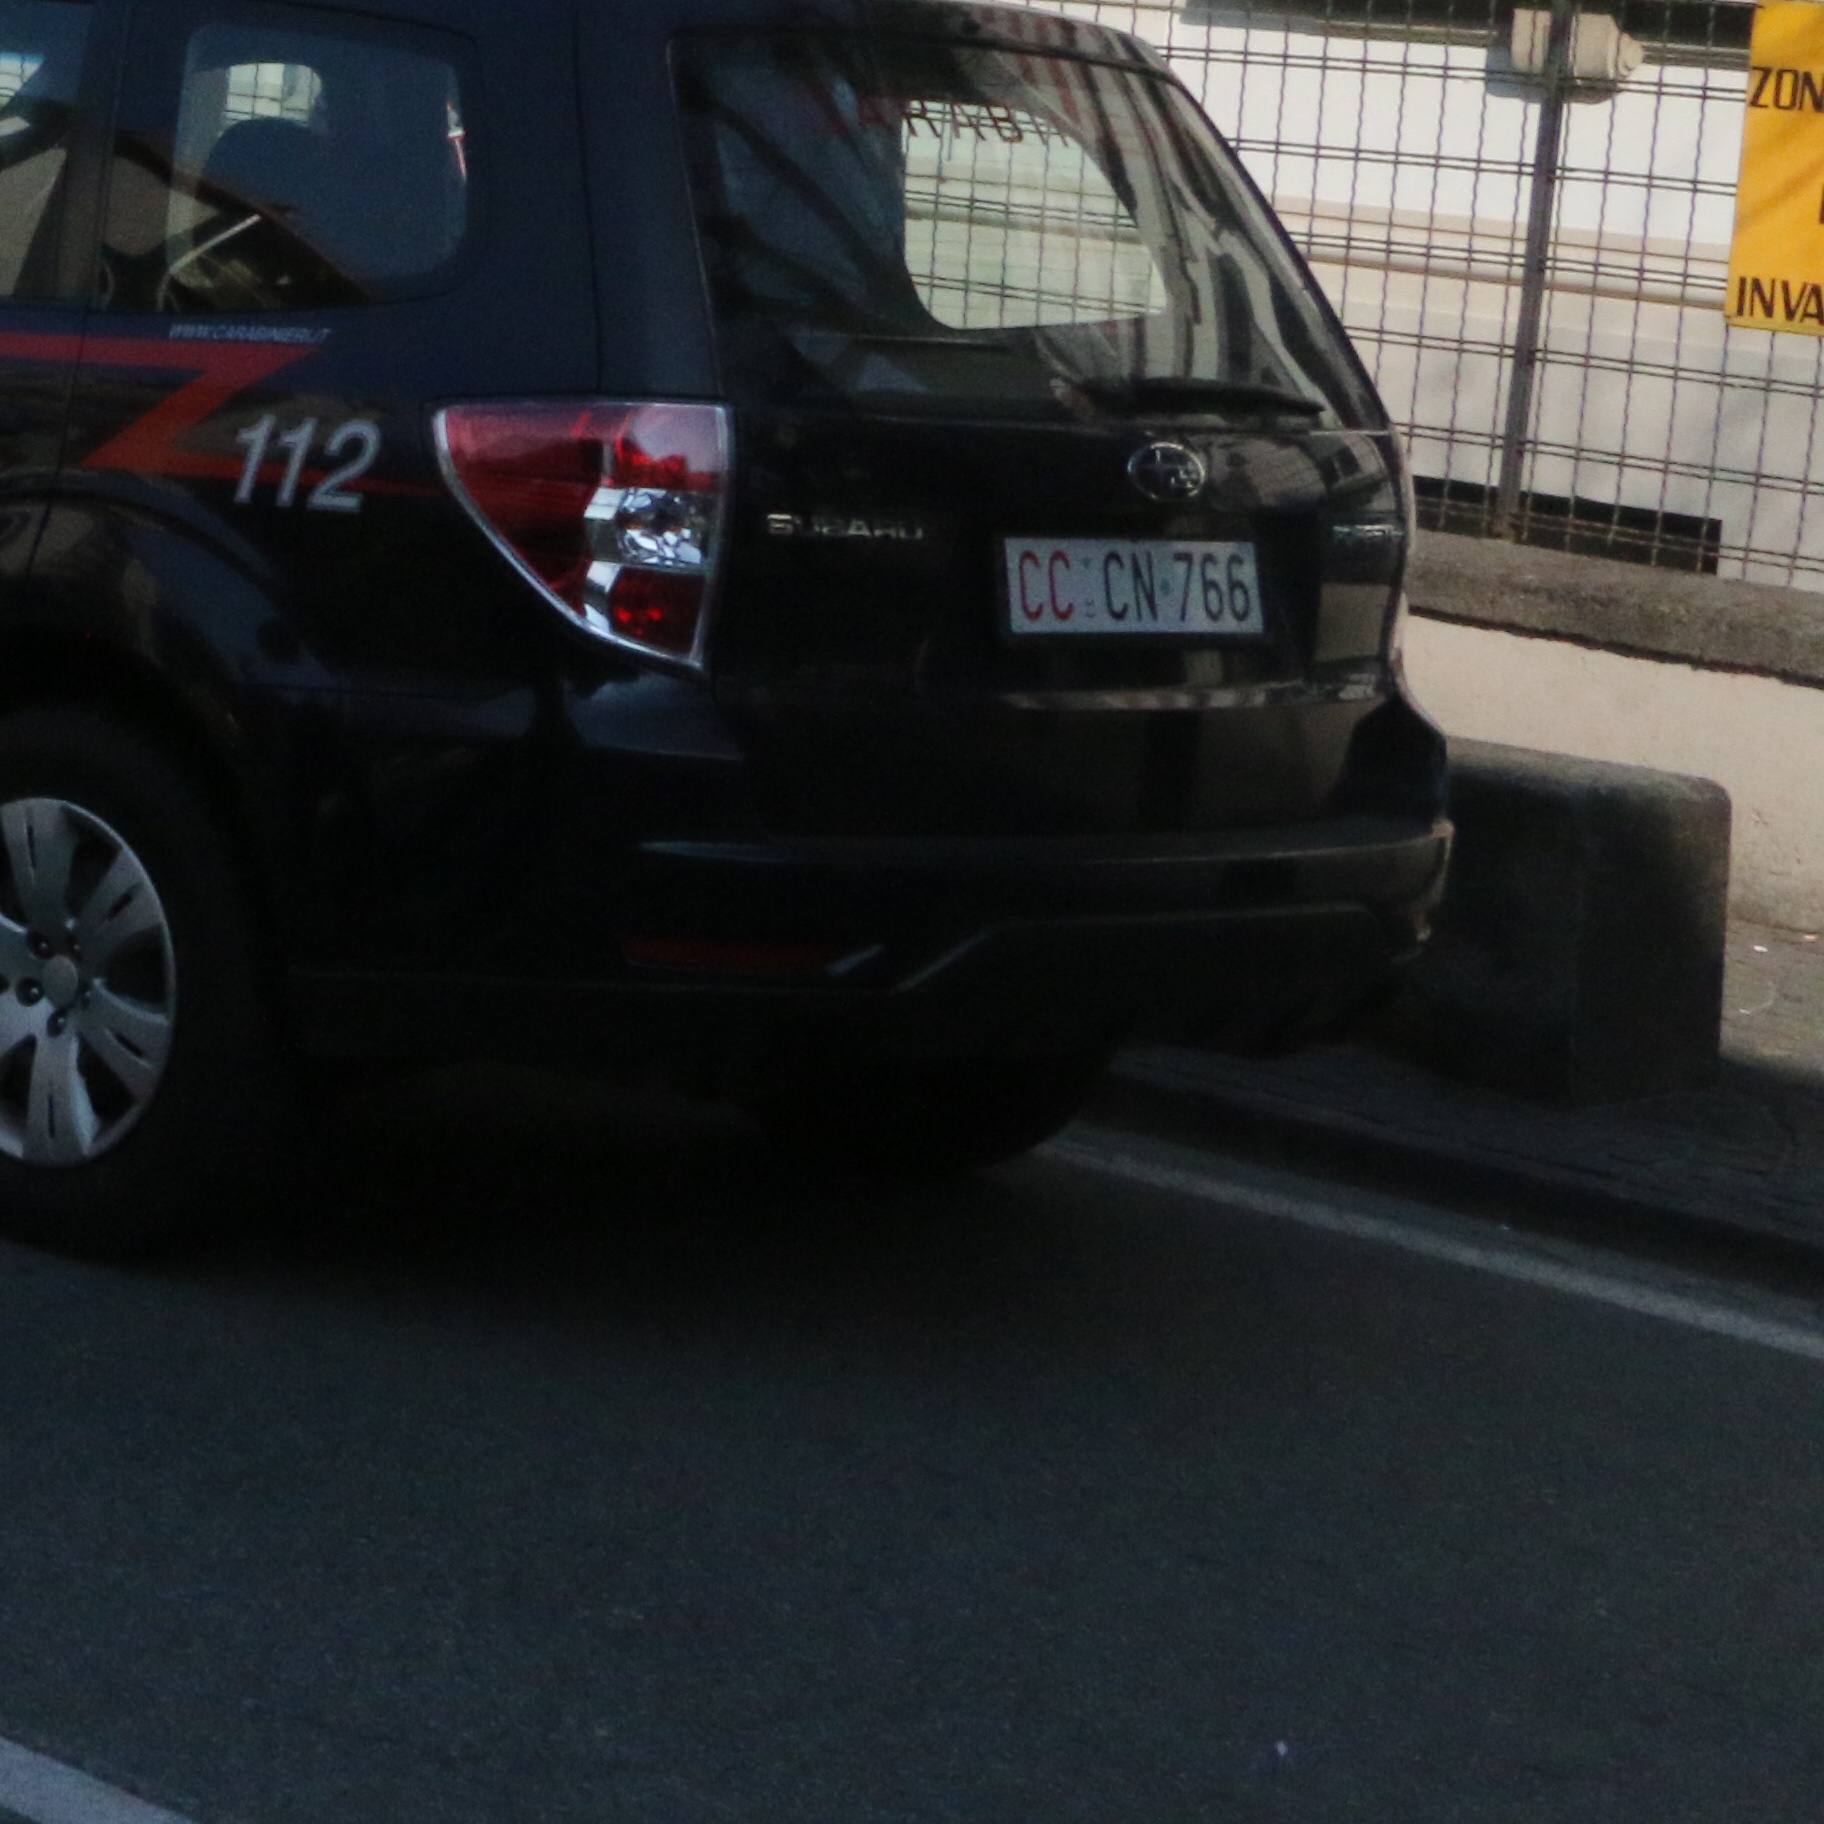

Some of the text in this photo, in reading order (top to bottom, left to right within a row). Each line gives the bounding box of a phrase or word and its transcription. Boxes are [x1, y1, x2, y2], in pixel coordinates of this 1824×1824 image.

[233, 413, 381, 513] 112
[1017, 549, 1251, 623] CC CN 766
